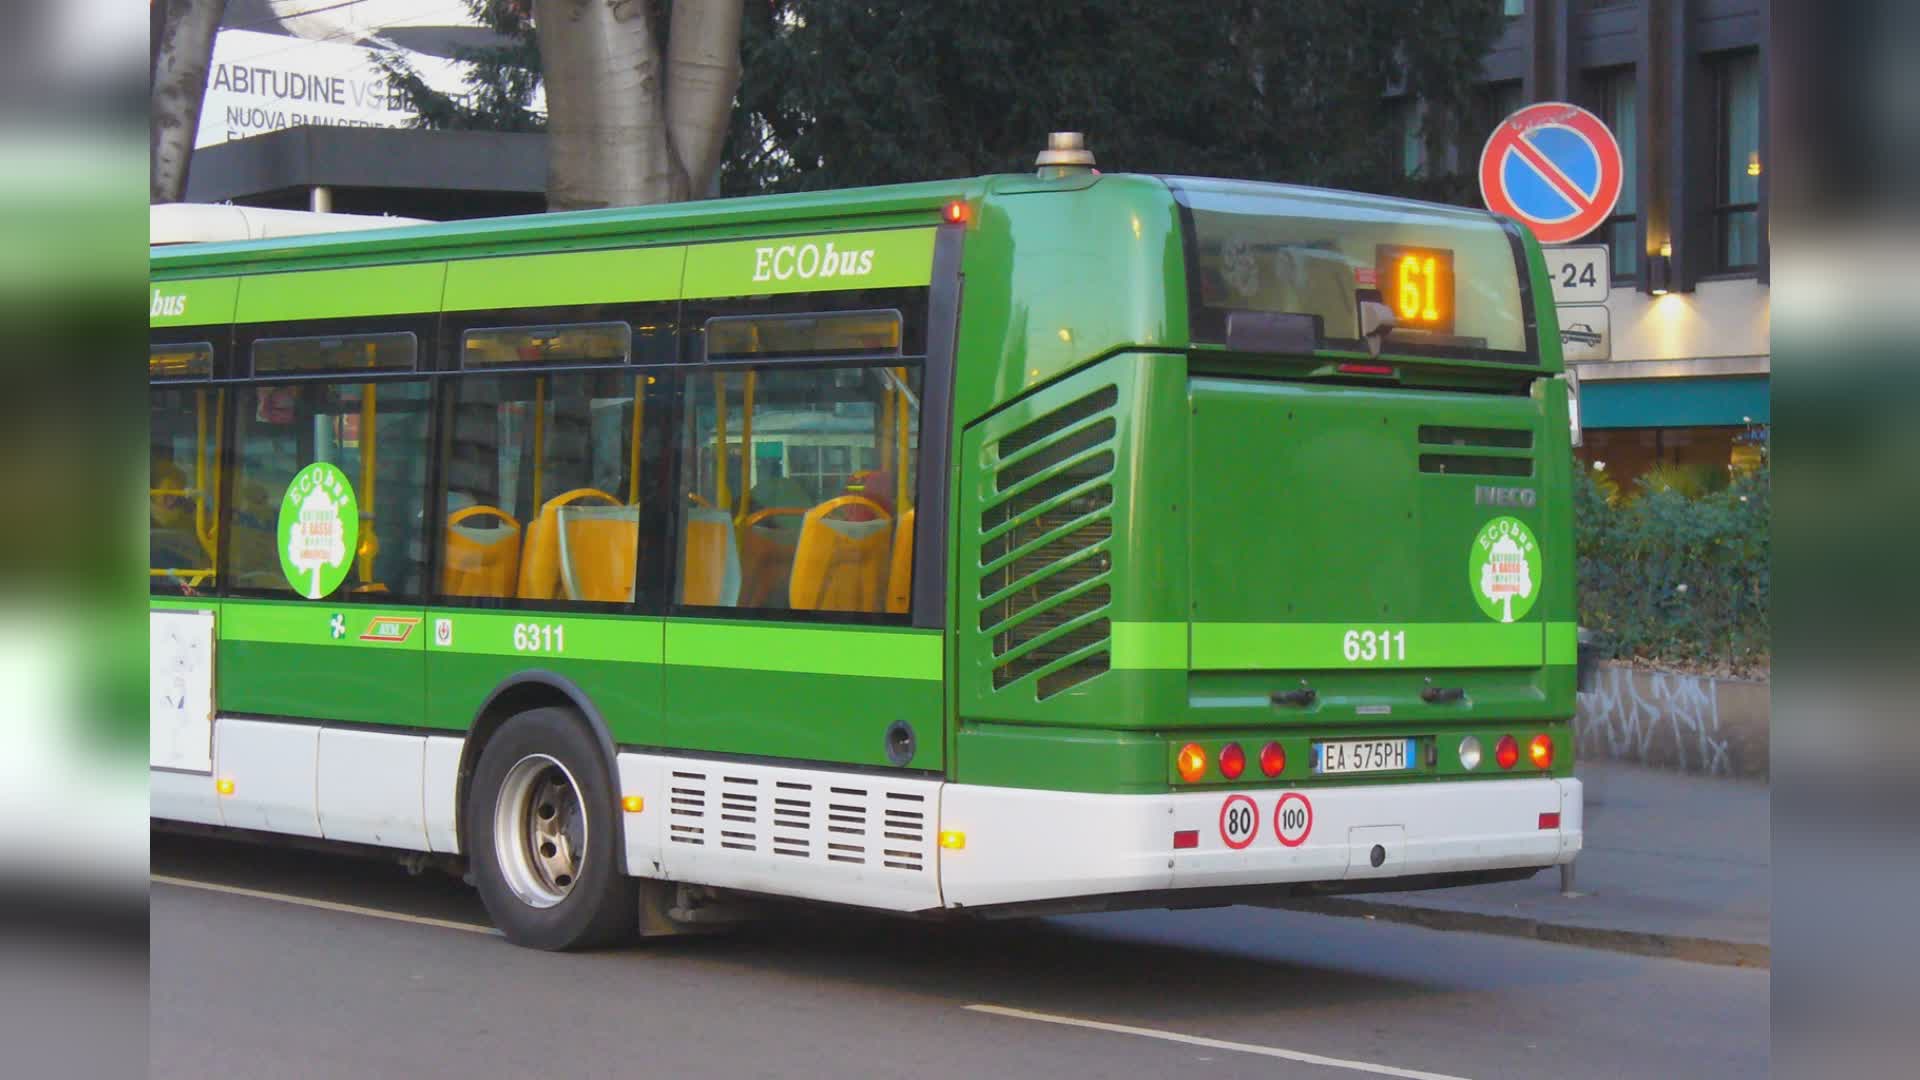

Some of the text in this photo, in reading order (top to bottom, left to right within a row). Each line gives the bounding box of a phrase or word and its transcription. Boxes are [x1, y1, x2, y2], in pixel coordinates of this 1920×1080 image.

[213, 63, 345, 105] ABITUDINE
[226, 105, 287, 129] NUOVA
[752, 242, 875, 281] ECObus
[1399, 254, 1439, 321] 61
[1475, 485, 1536, 507] IVECO
[513, 623, 564, 652] 6311
[1343, 630, 1406, 661] 6311
[1326, 742, 1405, 770] EA 575PH
[1229, 807, 1251, 835] 80
[1283, 809, 1305, 830] 100
